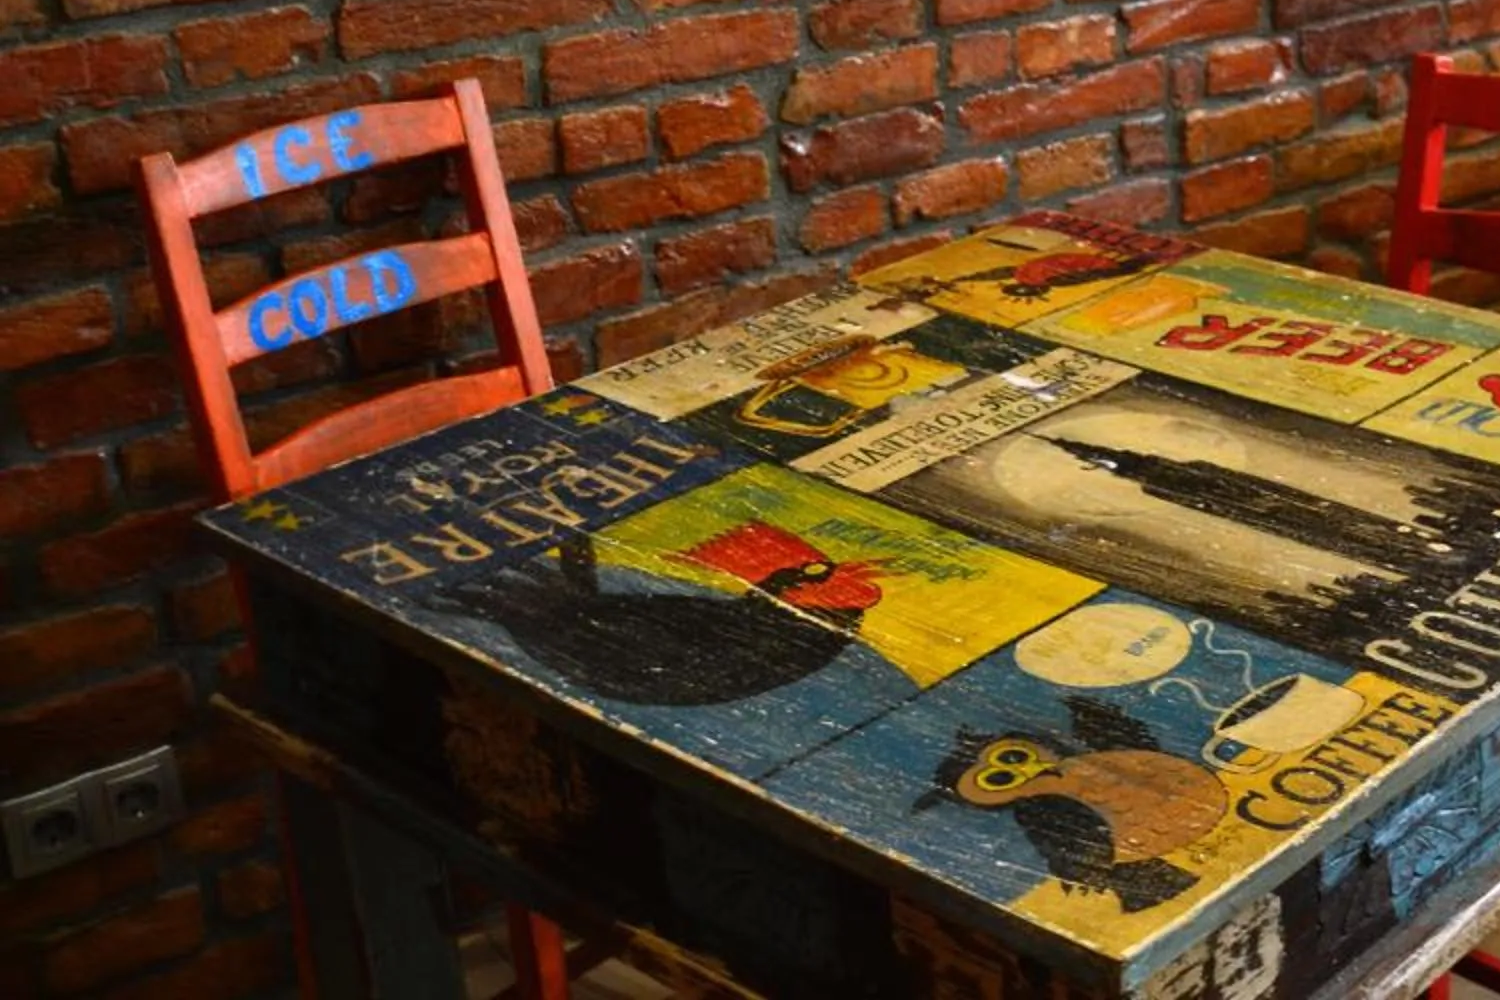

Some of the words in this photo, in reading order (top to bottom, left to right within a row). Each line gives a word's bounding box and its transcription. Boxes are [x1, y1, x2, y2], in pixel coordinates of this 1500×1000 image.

[235, 109, 374, 199] ICE
[248, 248, 418, 352] COLD
[1152, 311, 1456, 376] BEER
[339, 435, 696, 586] THEATRE
[384, 440, 577, 514] ROYAL
[1234, 691, 1458, 831] COFFEE
